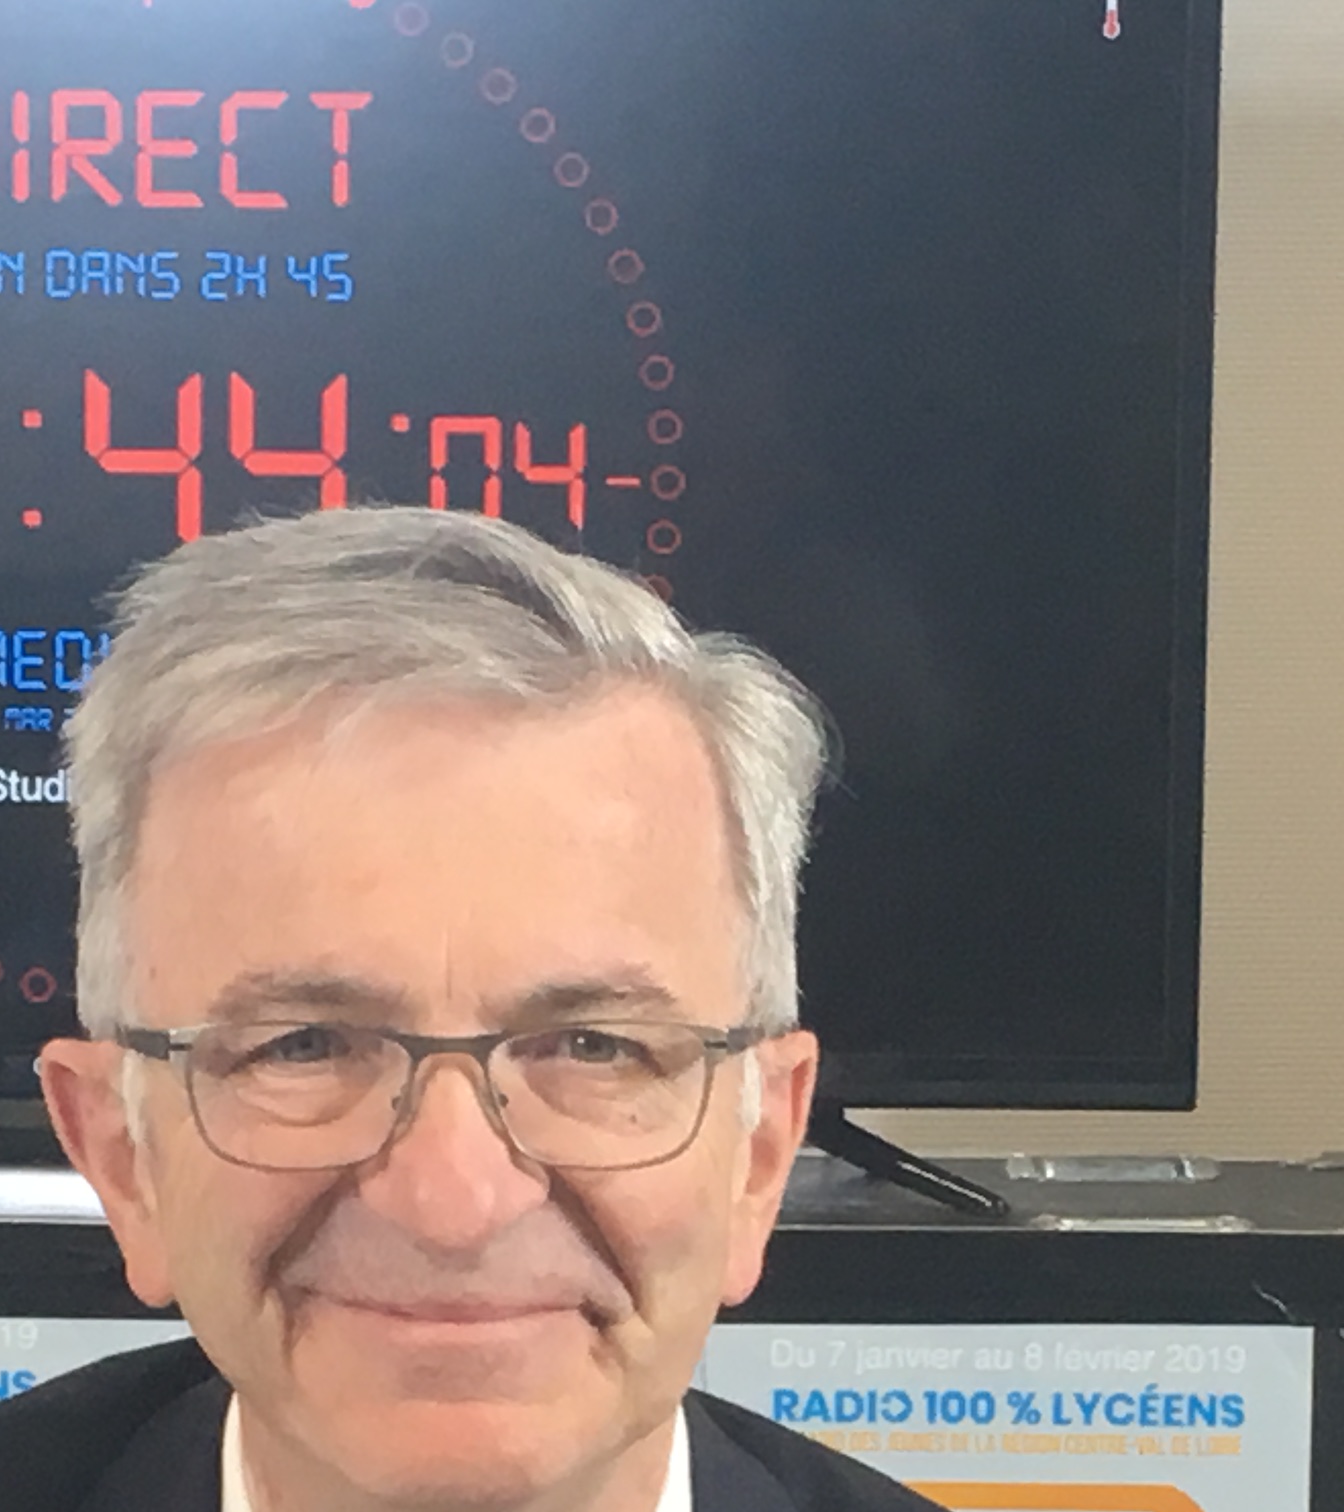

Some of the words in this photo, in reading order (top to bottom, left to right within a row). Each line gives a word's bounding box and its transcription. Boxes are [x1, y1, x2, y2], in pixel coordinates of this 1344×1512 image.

[44, 248, 181, 302] DANS
[201, 250, 268, 301] 2H
[286, 252, 354, 303] 45
[4, 707, 53, 732] MAR
[770, 1338, 817, 1369] Du
[827, 1340, 846, 1368] 7
[854, 1340, 964, 1377] janvier
[973, 1346, 1013, 1371] au
[1024, 1342, 1044, 1371] 8
[1055, 1340, 1157, 1373] février
[1164, 1343, 1247, 1374] 2019
[923, 1389, 996, 1425] 100
[1006, 1390, 1042, 1426] %
[1051, 1382, 1246, 1428] LYCÉENS
